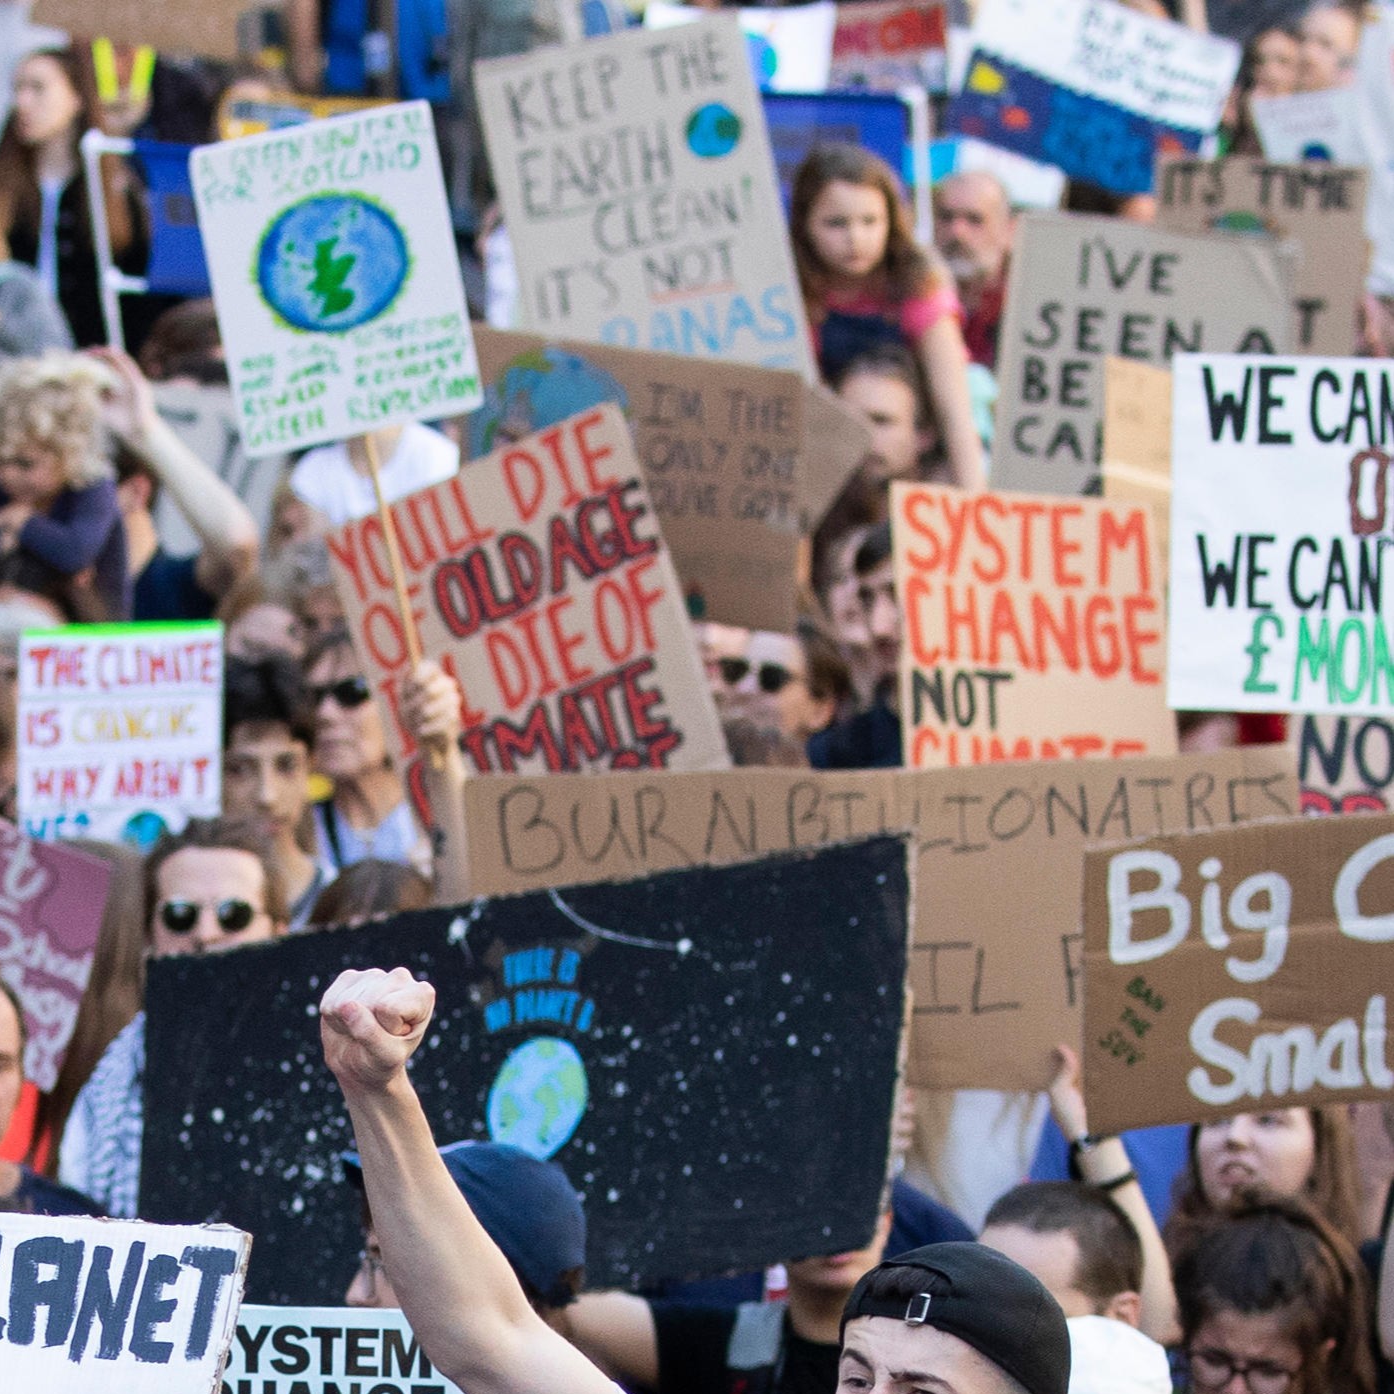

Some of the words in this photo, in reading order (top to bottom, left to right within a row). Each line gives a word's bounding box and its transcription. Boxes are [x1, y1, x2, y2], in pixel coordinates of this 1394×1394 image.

[504, 54, 620, 140] KEEP
[648, 32, 728, 95] THE
[1022, 303, 1206, 362] SEEN
[1202, 364, 1296, 444] WE
[502, 411, 620, 524] DIE
[1349, 446, 1394, 536] O
[431, 530, 544, 640] OLD
[548, 476, 660, 597] AGE
[905, 492, 1153, 592] SYSTEM
[1197, 533, 1276, 609] WE
[28, 644, 88, 687] THE
[97, 642, 216, 690] CLIMATE
[485, 597, 594, 712] DIE
[593, 554, 667, 664] OF
[905, 577, 1162, 685] CHANGE
[911, 669, 1014, 729] NOT
[33, 765, 104, 806] WHY
[1107, 846, 1296, 986] Big
[223, 1324, 434, 1380] YSTEM
